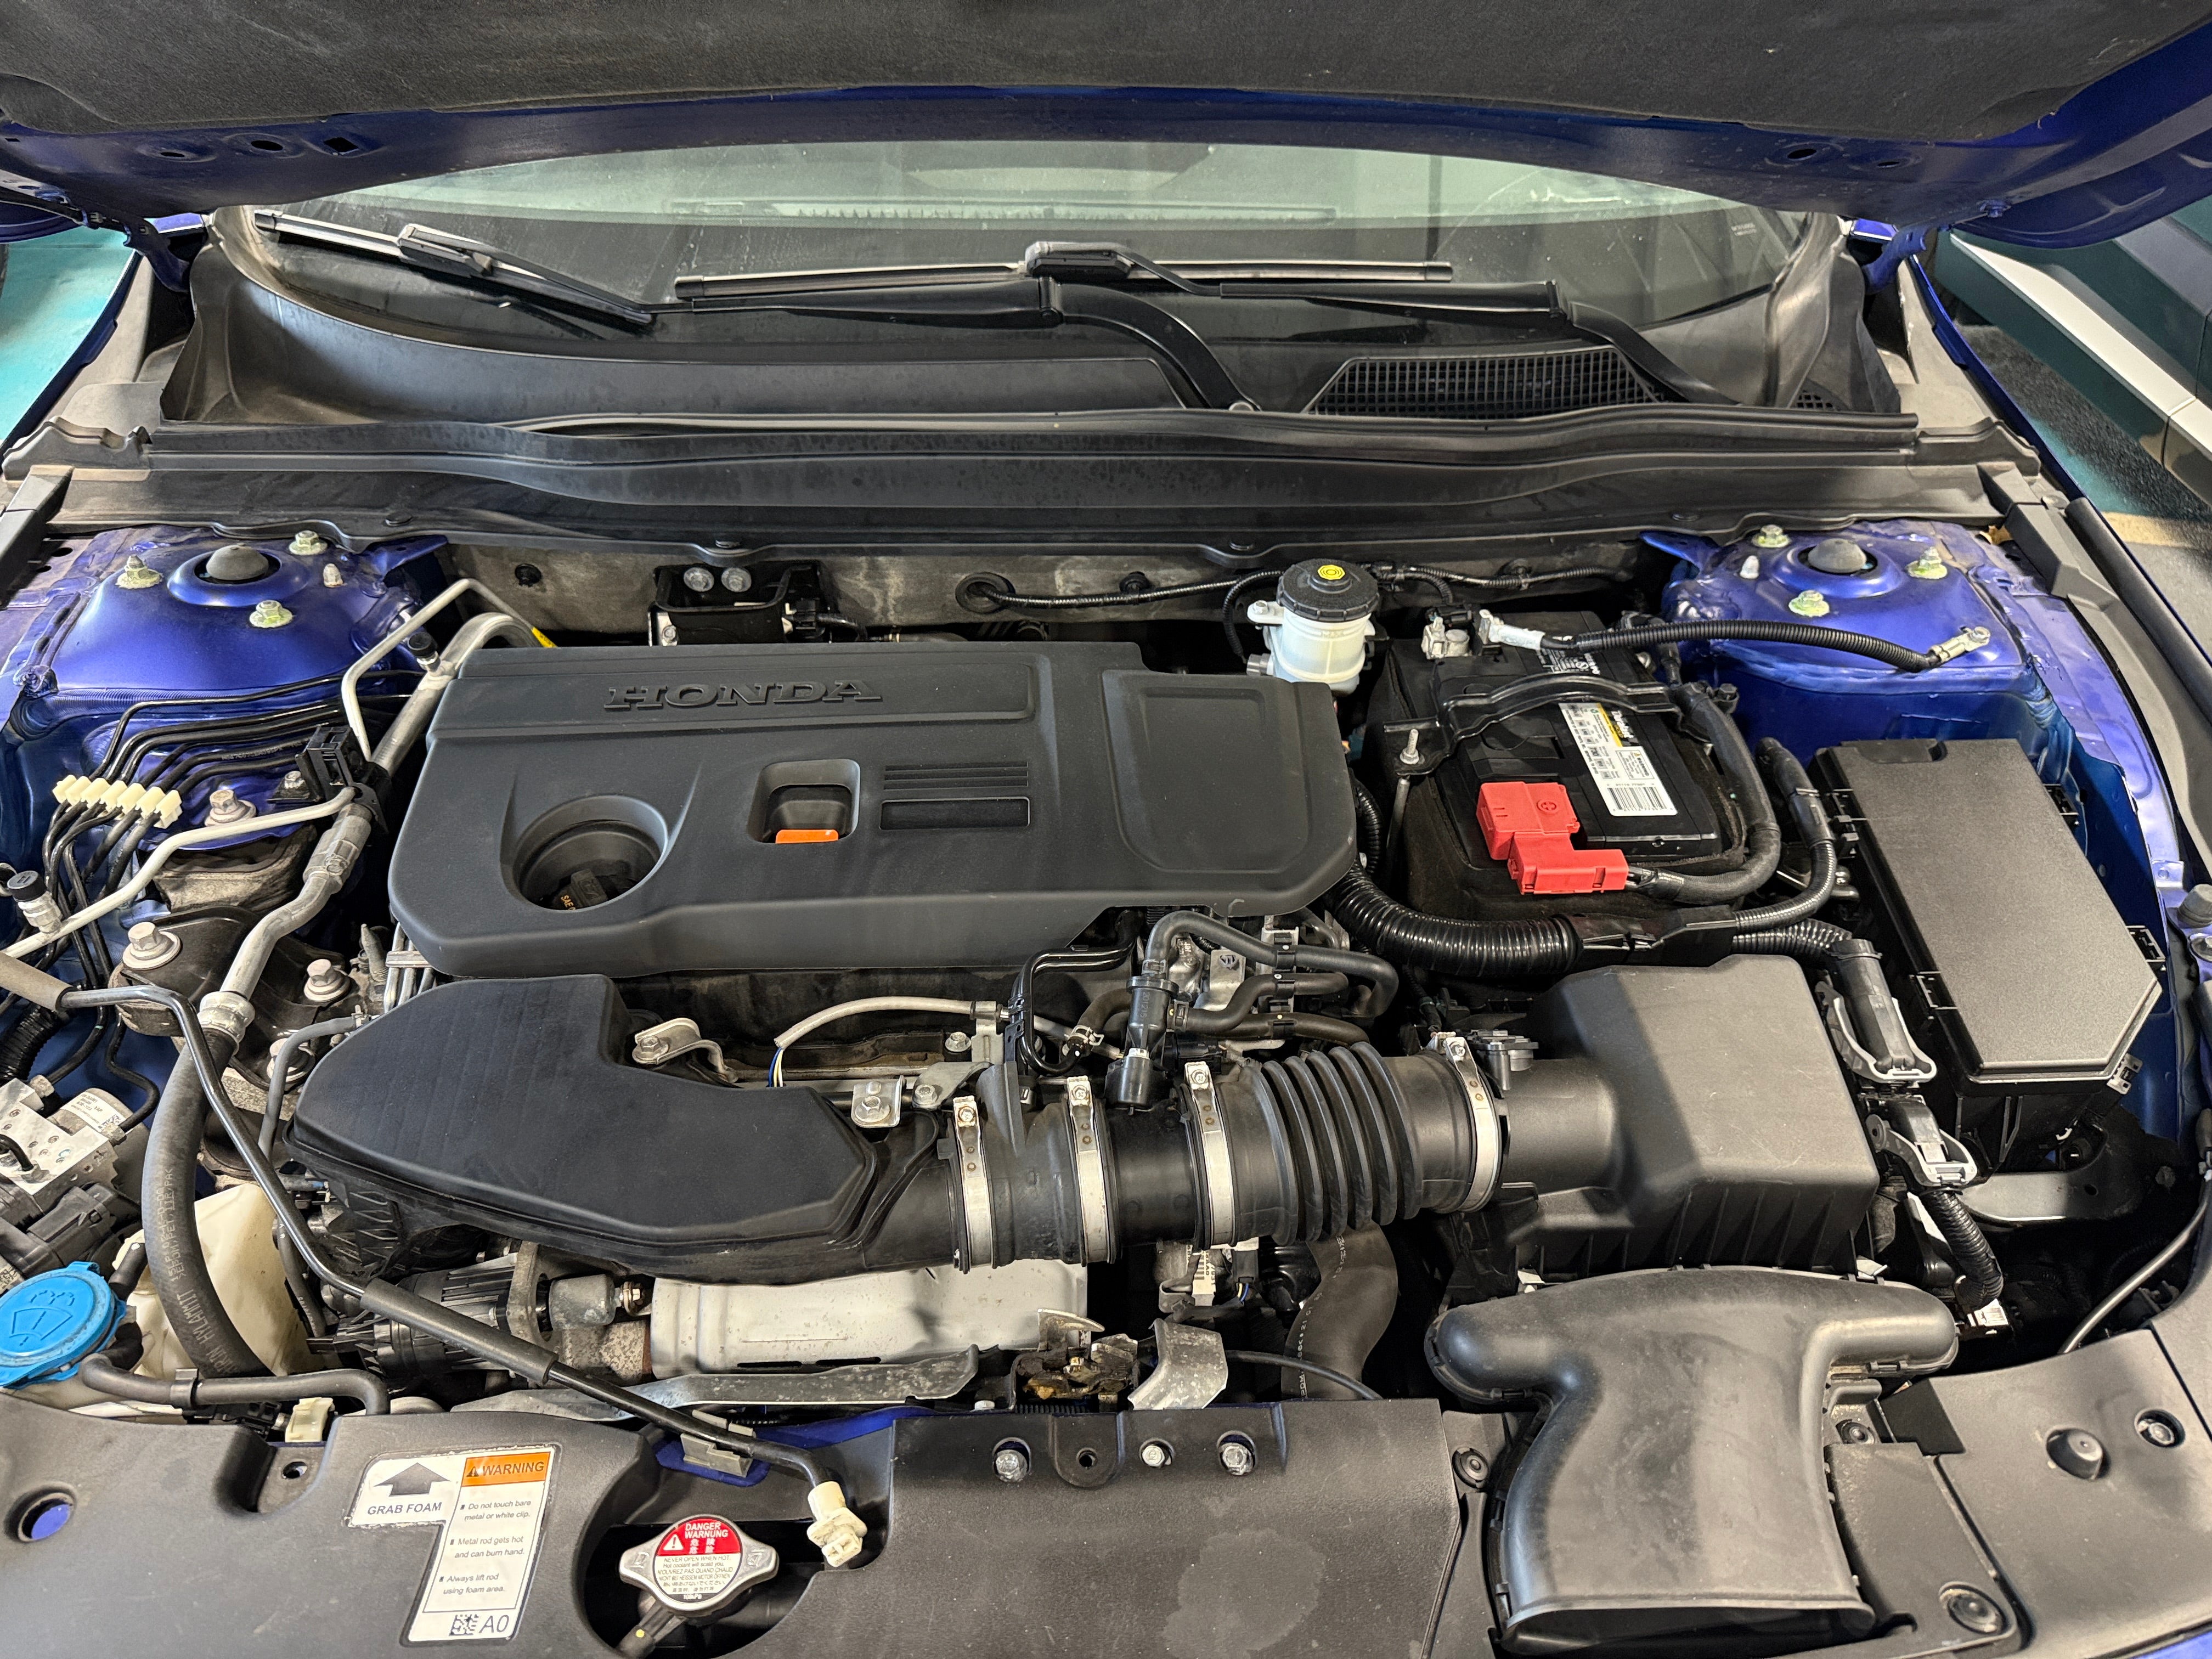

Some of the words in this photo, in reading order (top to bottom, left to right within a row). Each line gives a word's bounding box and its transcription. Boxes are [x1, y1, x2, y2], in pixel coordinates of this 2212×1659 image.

[604, 679, 882, 710] HONDA
[561, 895, 574, 908] SAE
[482, 1462, 544, 1475] WARNING
[368, 1504, 403, 1515] GRAB
[407, 1502, 442, 1513] FOAM
[516, 1511, 531, 1520] clip.
[685, 1522, 721, 1531] DANGER
[685, 1530, 729, 1539] WARNUNG
[494, 1537, 510, 1545] gets
[443, 1587, 464, 1595] using
